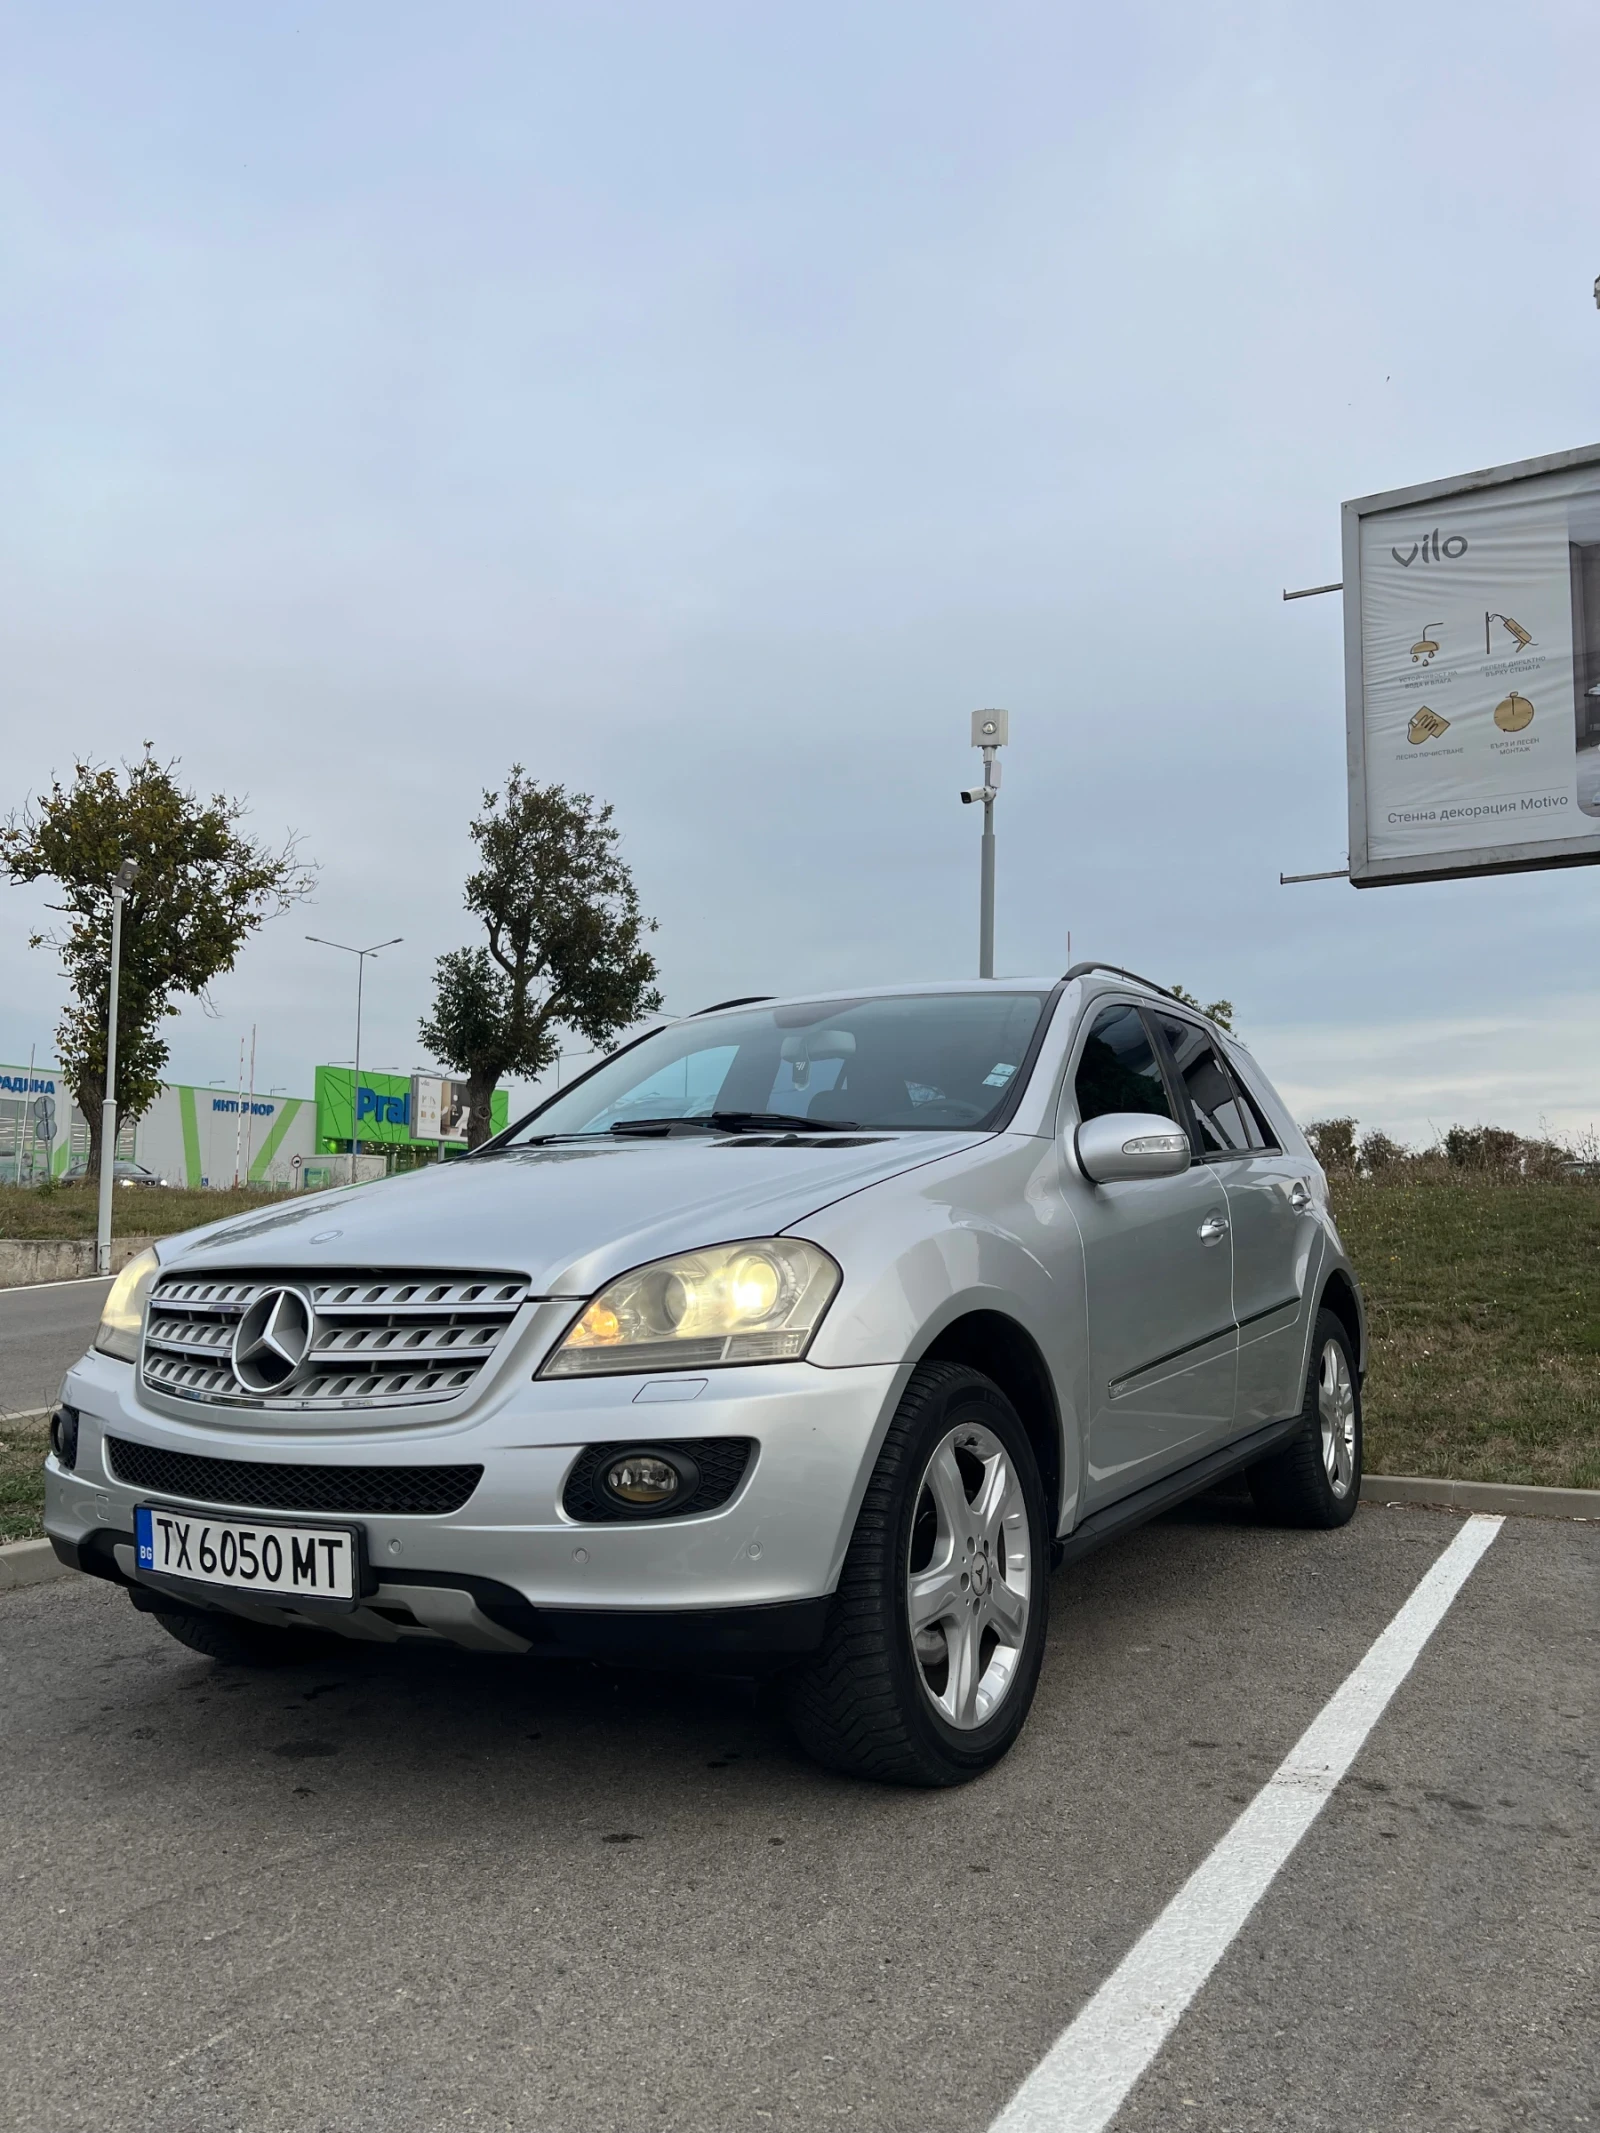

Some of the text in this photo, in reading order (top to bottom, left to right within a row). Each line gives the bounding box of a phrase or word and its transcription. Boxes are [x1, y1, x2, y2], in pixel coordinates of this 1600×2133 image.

[1392, 528, 1468, 567] vilo
[1508, 656, 1546, 668] ДИРЕКТНО
[1485, 664, 1541, 677] ВЪРХУ СТЕНАТА
[1404, 681, 1423, 689] ВОДА
[1430, 678, 1452, 686] ВЛАГА
[1490, 738, 1540, 749] БЪРЗ И ЛЕСЕН
[1500, 746, 1531, 755] МОНТАЖ
[1395, 747, 1465, 761] ЛЕСНО ПОЧИСТВАНЕ
[1387, 796, 1568, 824] Стенна декорация Motivo
[0, 1075, 56, 1095] АДИНА
[212, 1098, 275, 1116] ИНТЕРИОР
[139, 1545, 153, 1560] BG
[199, 1527, 283, 1583] 6050
